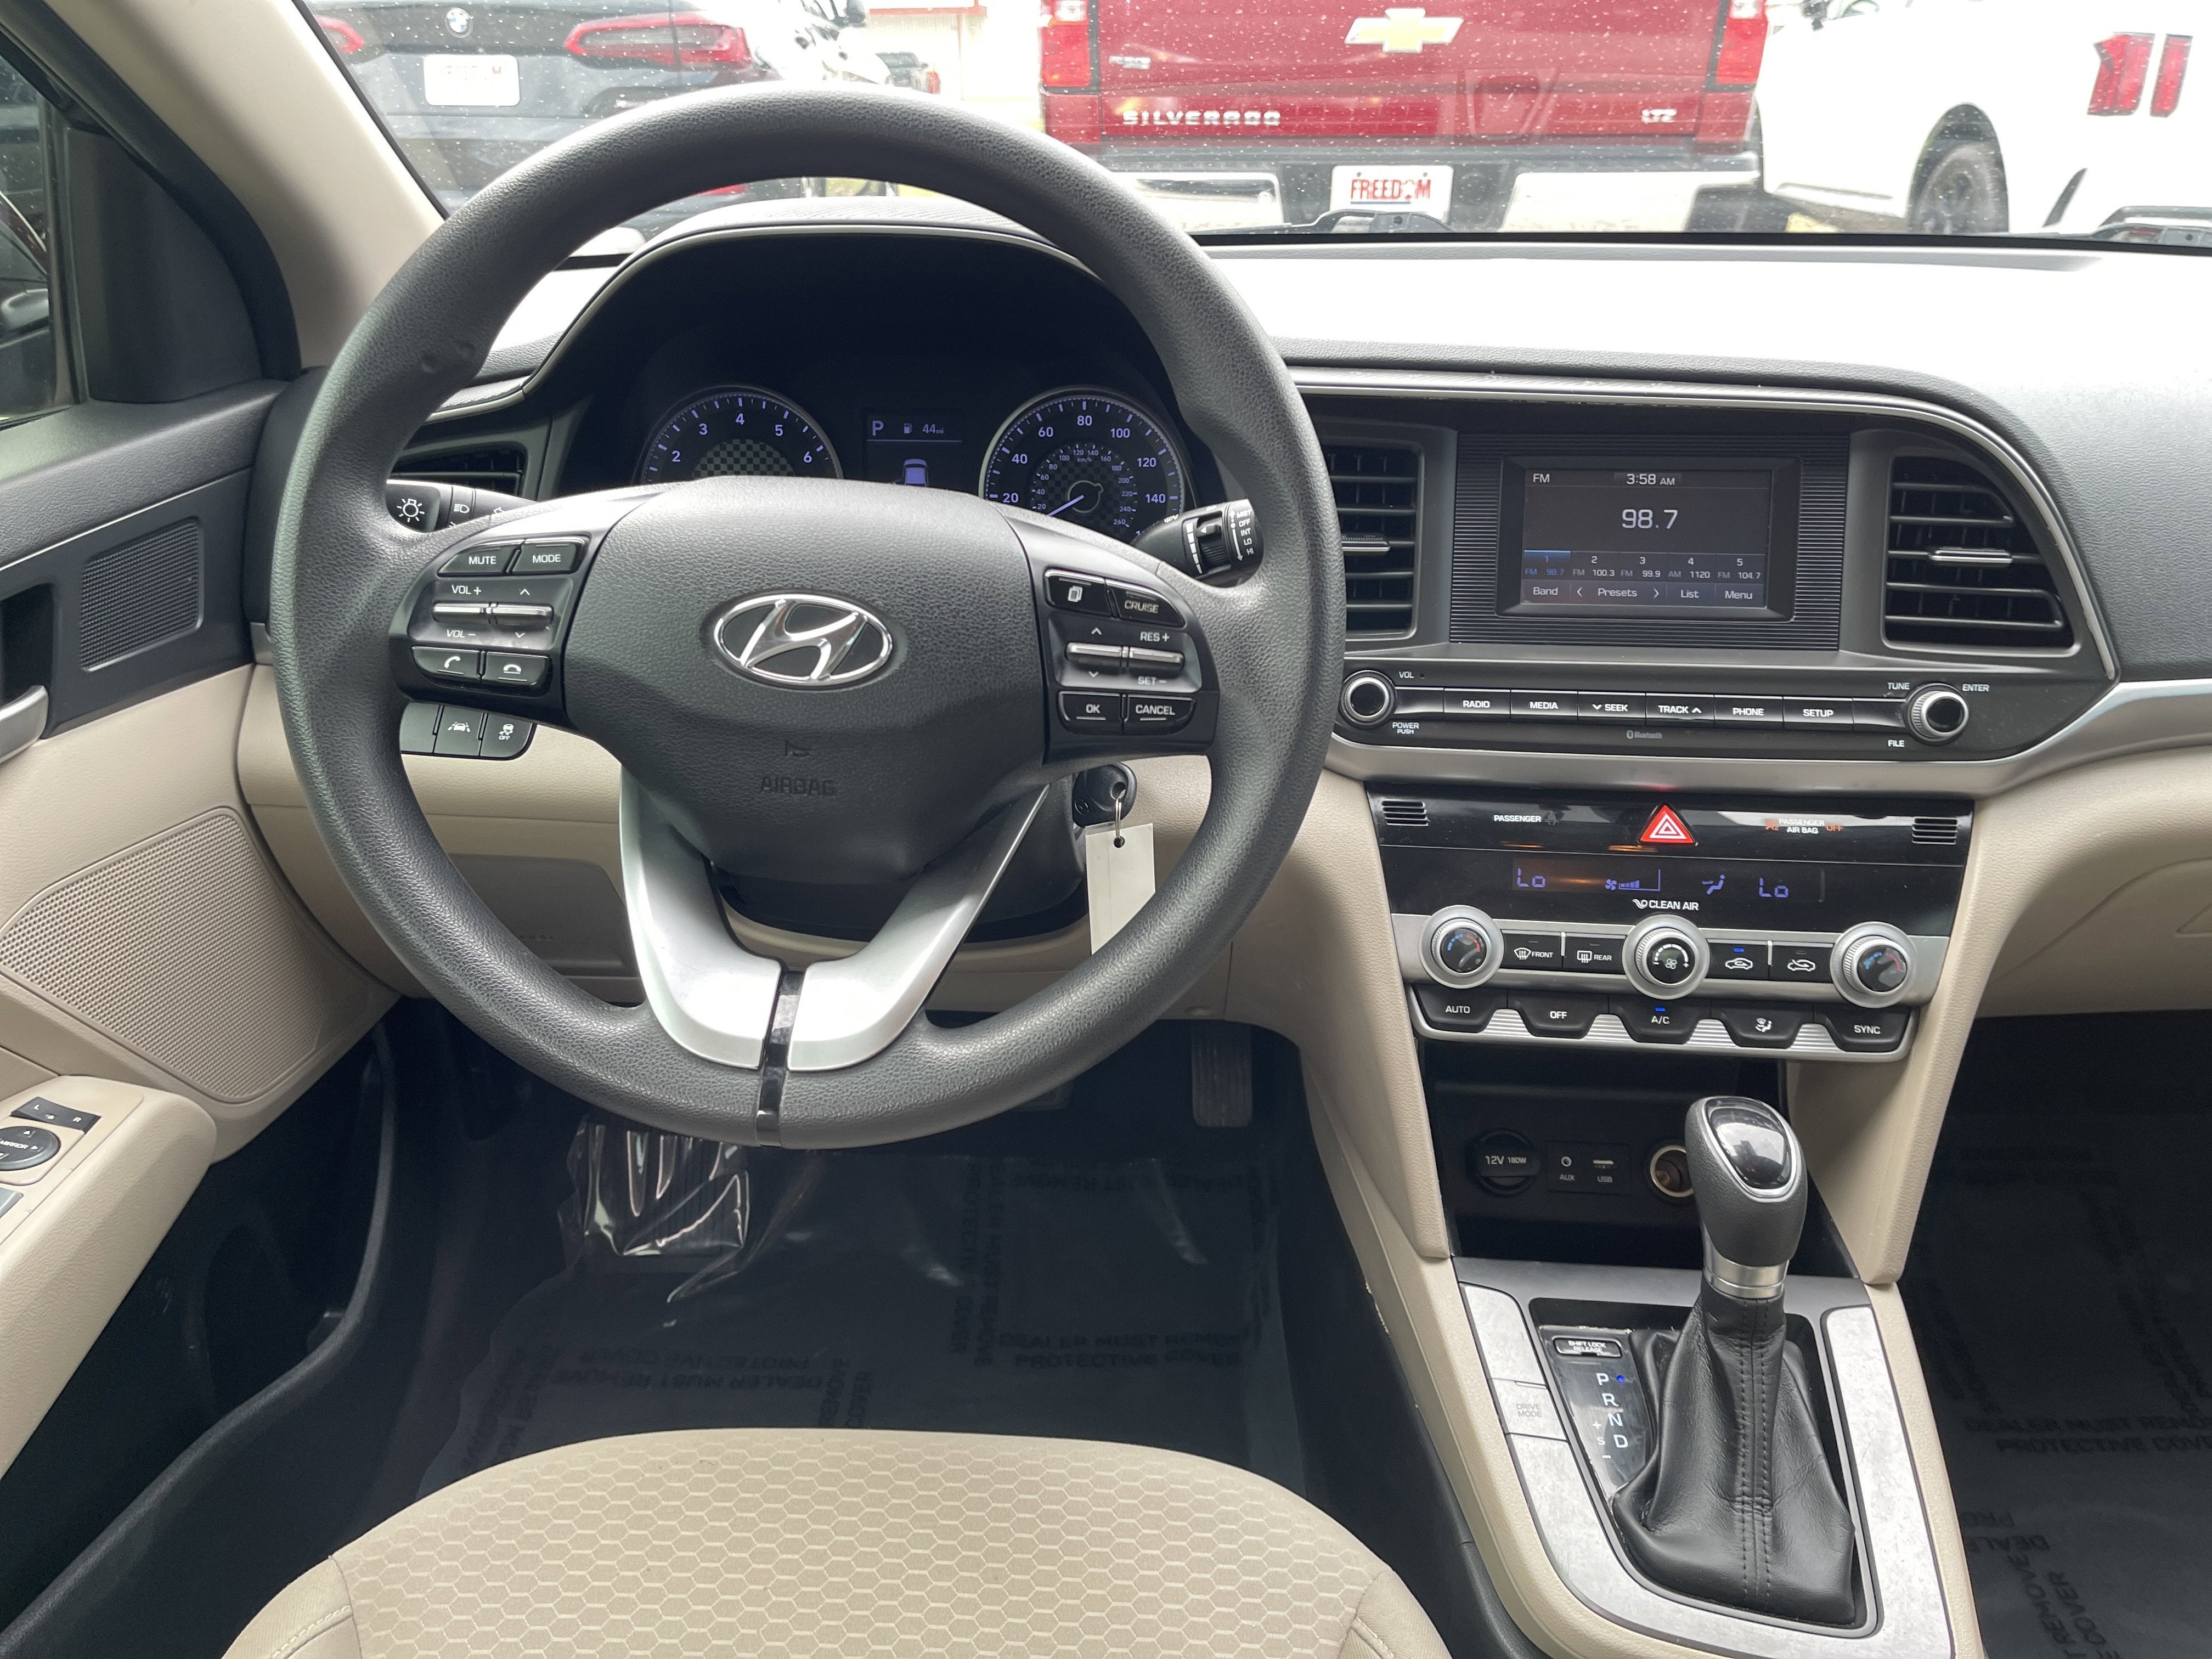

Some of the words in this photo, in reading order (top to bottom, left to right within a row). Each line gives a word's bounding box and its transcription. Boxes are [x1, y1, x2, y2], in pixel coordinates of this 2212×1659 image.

[1122, 110, 1281, 126] SILVERADO
[735, 413, 745, 425] 4
[1077, 415, 1092, 426] 80
[699, 423, 708, 435] 3
[775, 424, 783, 436] 5
[872, 420, 884, 436] P
[1038, 426, 1054, 437] 60
[1110, 428, 1130, 438] 100
[672, 450, 681, 462] 2
[803, 451, 812, 463] 6
[1012, 453, 1028, 464] 40
[1137, 457, 1156, 467] 120
[1533, 473, 1550, 483] FM
[1626, 473, 1656, 485] 3:58
[1660, 477, 1675, 486] AM
[1002, 492, 1019, 503] 20
[1146, 494, 1166, 504] 140
[1239, 518, 1251, 527] OFF
[1622, 509, 1678, 529] 98.7
[1240, 527, 1251, 537] INT
[1243, 538, 1252, 546] LO
[1246, 548, 1255, 556] HI
[469, 556, 496, 565] MUTE
[532, 554, 561, 563] MODE
[1592, 556, 1598, 564] 2
[1639, 556, 1646, 565] 3
[1737, 558, 1743, 566] 5
[451, 585, 471, 595] VOL
[1533, 586, 1558, 596] Band
[1598, 588, 1638, 597] Presets
[1680, 589, 1699, 599] List
[1725, 590, 1753, 600] Menu
[1125, 600, 1159, 614] CRUISE
[446, 630, 465, 638] VOL
[1140, 631, 1160, 642] RES
[1399, 671, 1414, 679] VOL
[1138, 676, 1157, 685] SET
[1888, 682, 1910, 690] TUNE
[1962, 684, 1989, 692] ENTER
[1086, 703, 1101, 714] OK
[1463, 700, 1491, 709] RADIO
[1530, 701, 1558, 710] MEDIA
[1604, 703, 1628, 712] SEEK
[1658, 705, 1689, 714] TRACK
[1135, 704, 1176, 716] CANCEL
[1733, 707, 1764, 716] PHONE
[1803, 709, 1833, 718] SETUP
[1888, 739, 1905, 747] FILE
[761, 776, 837, 797] AIRBAG
[1493, 815, 1542, 823] PASSENGER
[1779, 818, 1825, 826] PASSENGER
[1649, 900, 1680, 910] CLEAN
[1682, 901, 1699, 911] AIR
[1445, 1005, 1470, 1014] AUTO
[1550, 1011, 1567, 1019] OFF
[1651, 1015, 1669, 1025] A/C
[1854, 1025, 1881, 1034] SYNC
[1485, 1156, 1504, 1165] 12V
[1596, 1373, 1609, 1386] P
[1602, 1393, 1618, 1406] R
[1608, 1414, 1623, 1426] N
[1597, 1437, 1605, 1446] S
[1614, 1435, 1628, 1448] D
